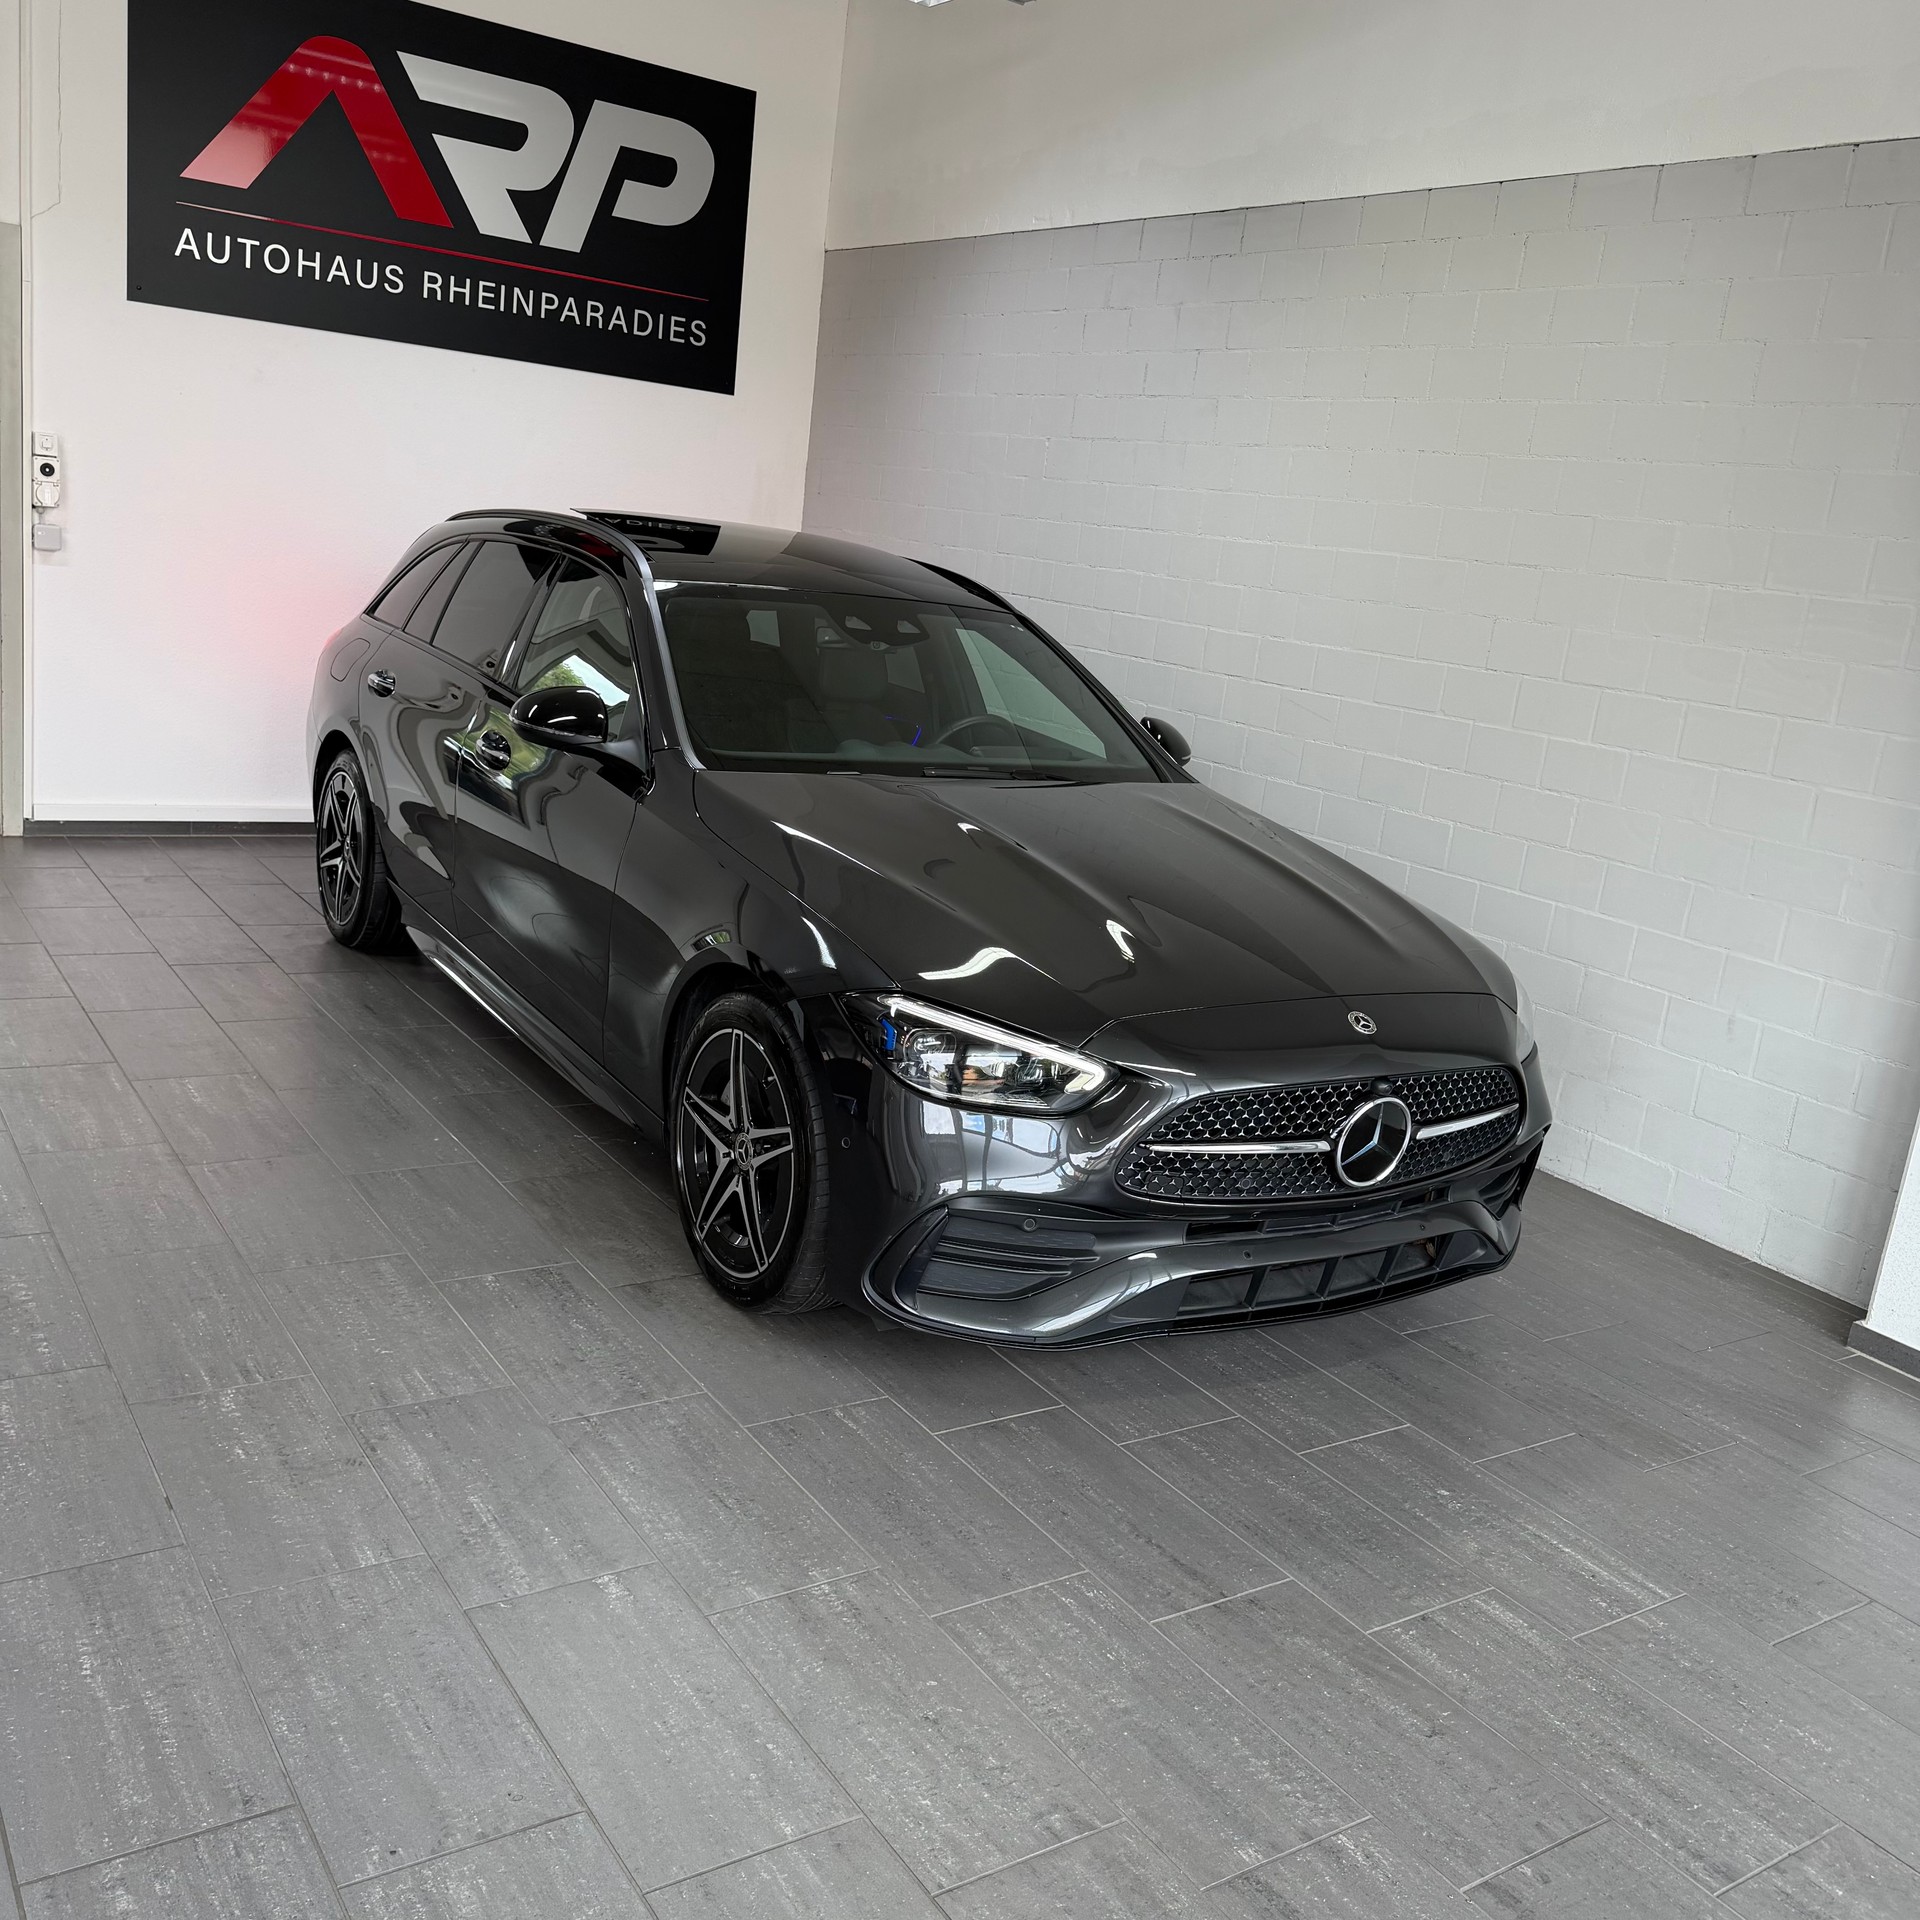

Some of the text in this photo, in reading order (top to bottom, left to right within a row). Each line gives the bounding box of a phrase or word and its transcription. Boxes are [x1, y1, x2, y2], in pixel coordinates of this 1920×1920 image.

[180, 35, 715, 254] ARP
[174, 227, 707, 347] AUTOHAUS RHEINPARADIES
